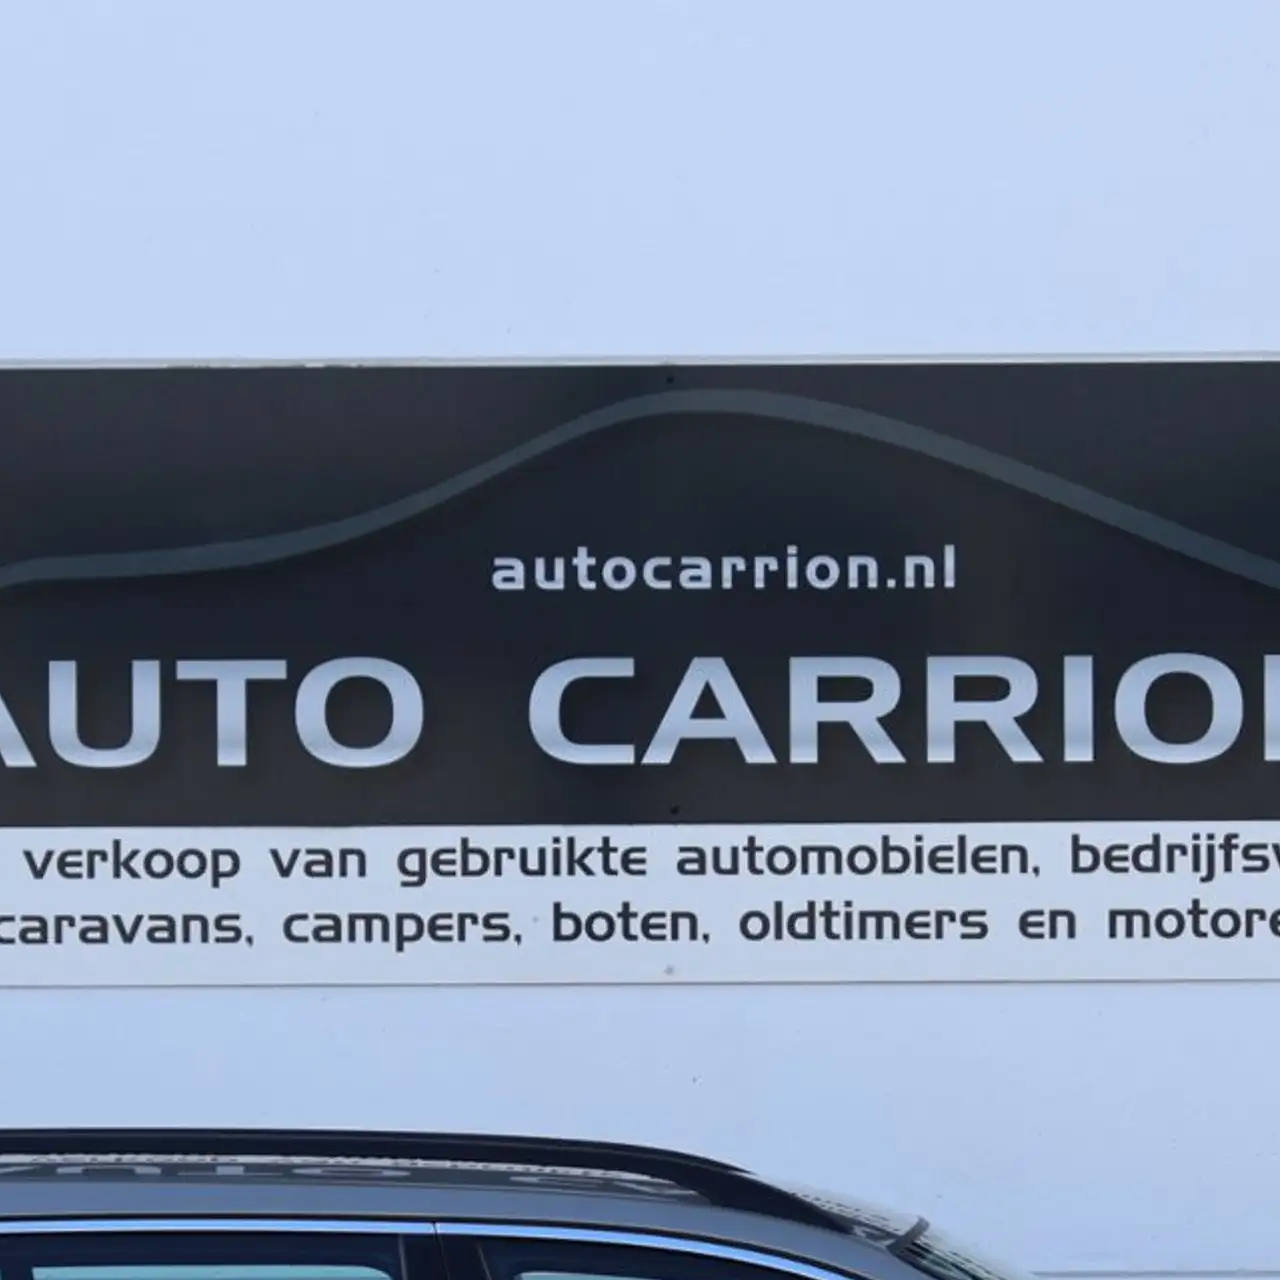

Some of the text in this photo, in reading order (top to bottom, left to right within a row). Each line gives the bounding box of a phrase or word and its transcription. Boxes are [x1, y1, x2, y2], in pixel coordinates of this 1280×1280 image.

[492, 544, 957, 591] autocarrion.nl
[23, 838, 241, 889] verkoop
[269, 848, 367, 878] van
[397, 836, 647, 888] gebruikte
[676, 834, 1040, 877] automobielen,
[283, 912, 522, 953] campers,
[552, 901, 710, 944] boten,
[739, 900, 989, 941] oldtimers
[1018, 909, 1076, 940] en
